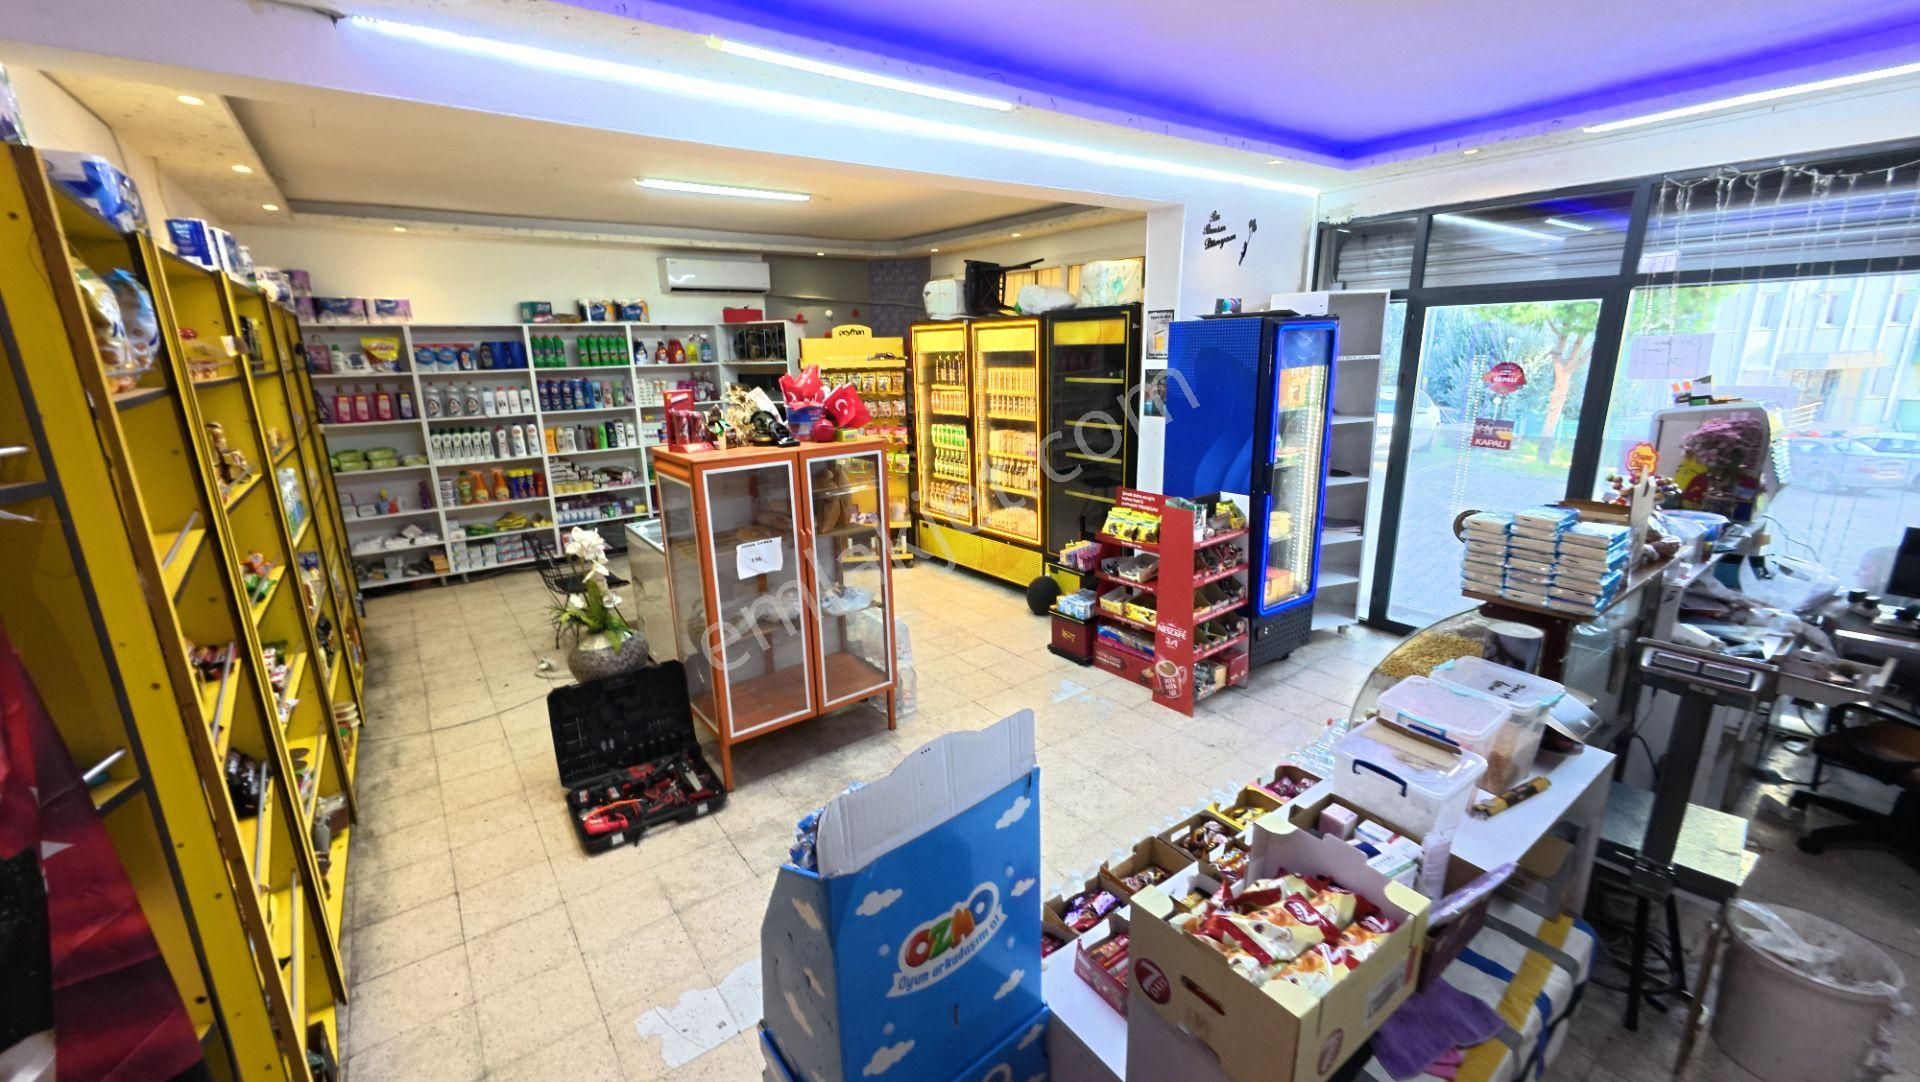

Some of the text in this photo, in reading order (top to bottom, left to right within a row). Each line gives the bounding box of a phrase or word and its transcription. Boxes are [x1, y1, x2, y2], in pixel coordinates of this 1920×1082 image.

[1475, 438, 1507, 448] KAPALI
[904, 889, 994, 968] OZMO
[898, 972, 929, 991] Oyun
